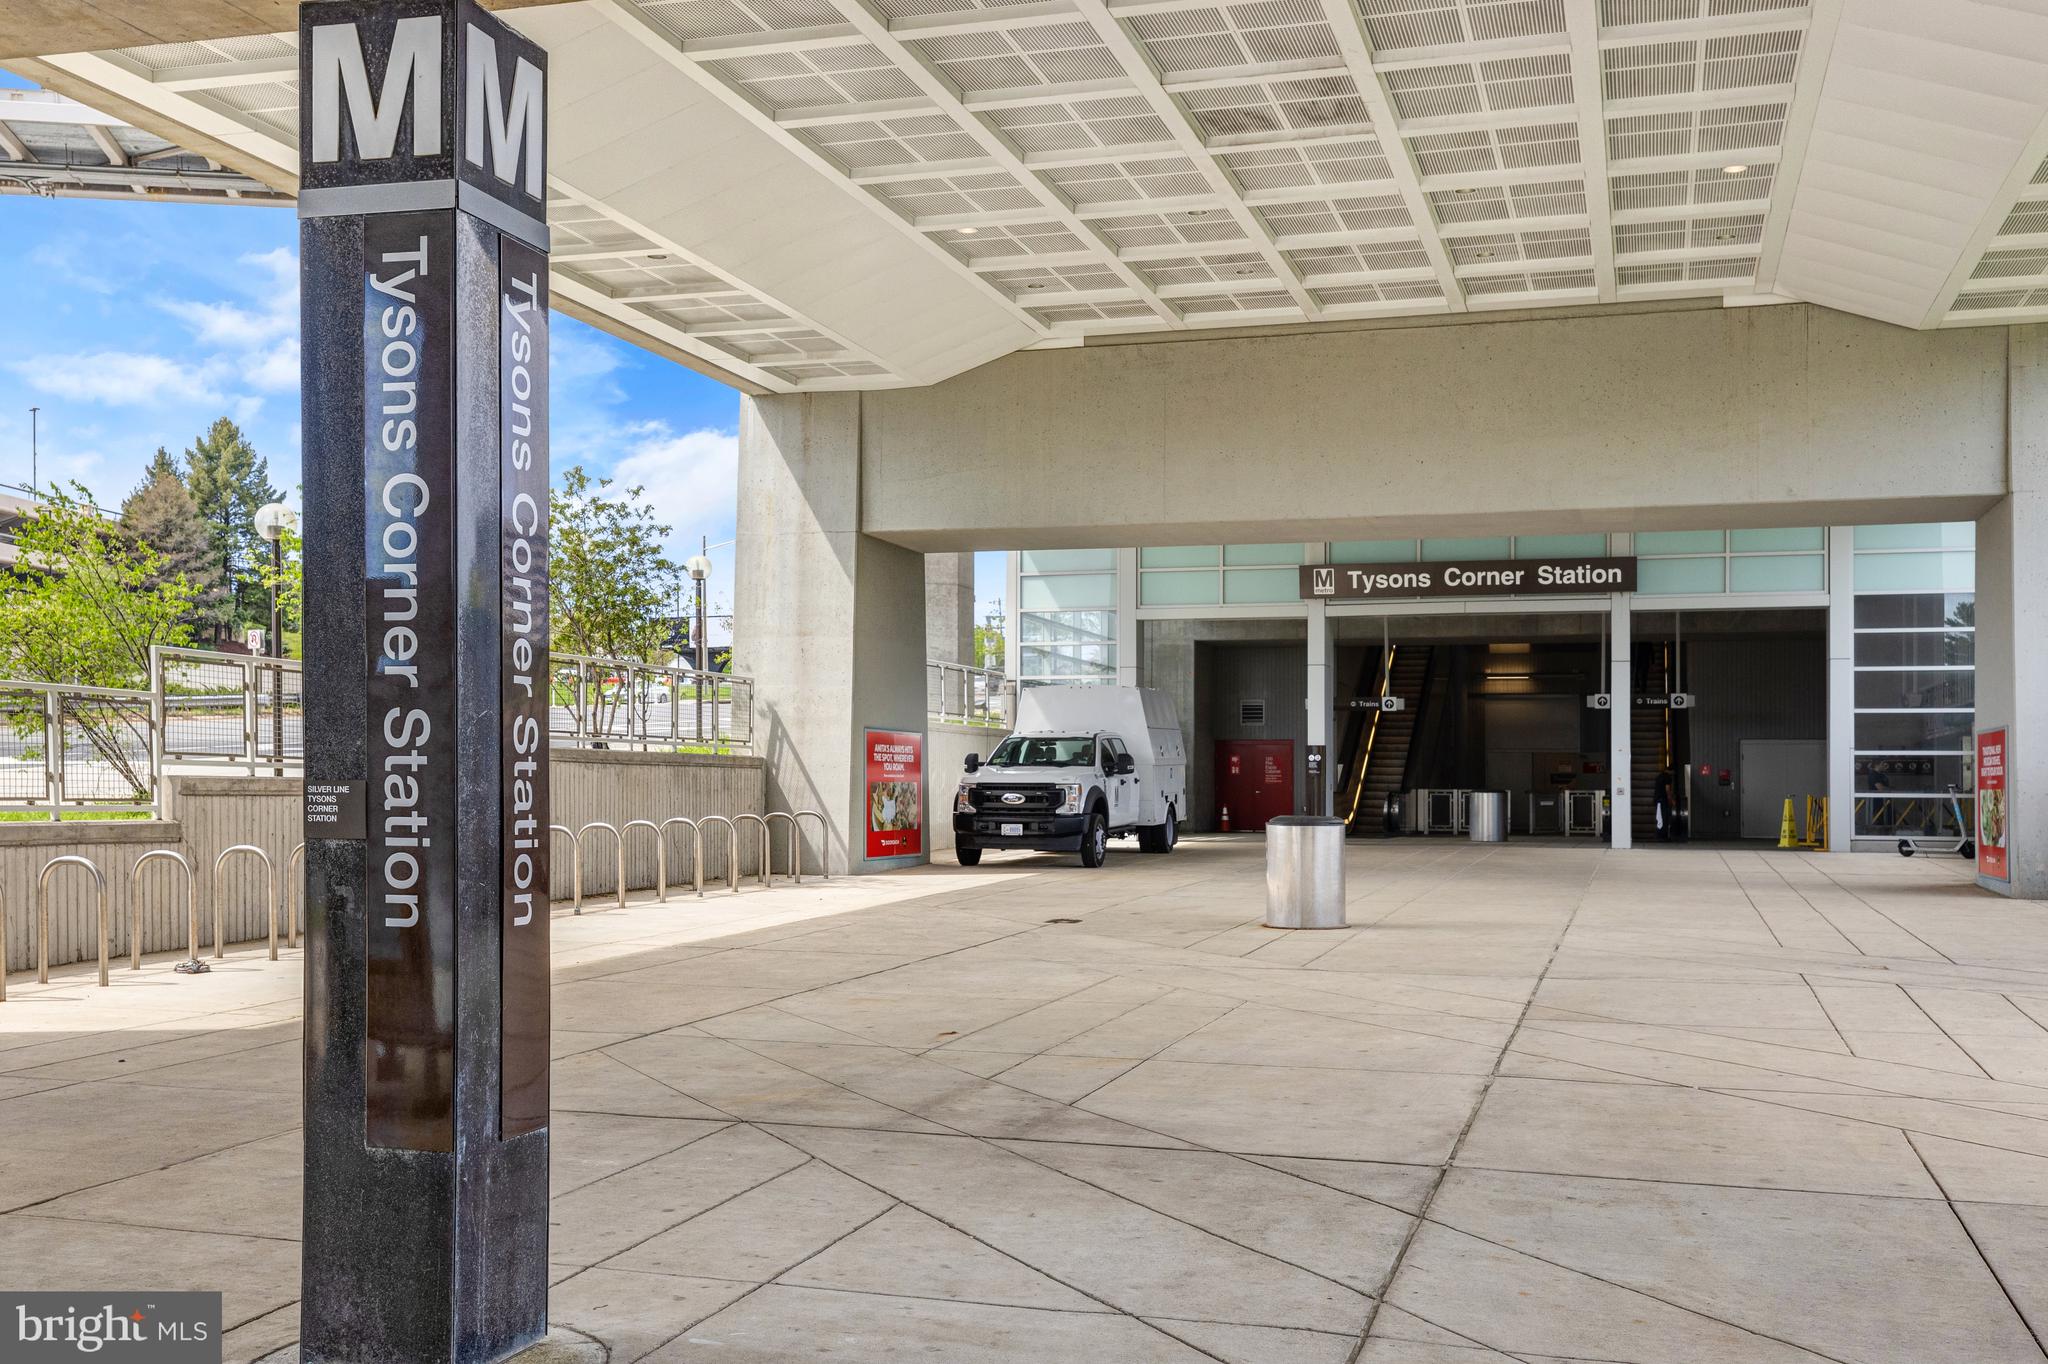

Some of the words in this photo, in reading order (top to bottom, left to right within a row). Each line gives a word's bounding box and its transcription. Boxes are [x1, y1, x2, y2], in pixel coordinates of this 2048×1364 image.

[313, 15, 442, 163] M
[465, 22, 543, 201] M
[369, 235, 428, 452] Tysons
[505, 272, 538, 472] Tysons
[382, 472, 430, 688] Corner
[512, 493, 538, 698] Corner
[1315, 570, 1333, 587] M
[1347, 570, 1431, 594] Tysons
[1444, 567, 1525, 587] Corner
[1537, 565, 1622, 586] Station
[1646, 697, 1668, 705] Trains
[307, 785, 332, 793] SILVER
[333, 785, 350, 793] LINE
[307, 795, 337, 803] TYSONS
[307, 804, 338, 812] CORNER
[307, 814, 337, 822] STATION
[383, 707, 431, 927] Station
[513, 714, 539, 927] Station
